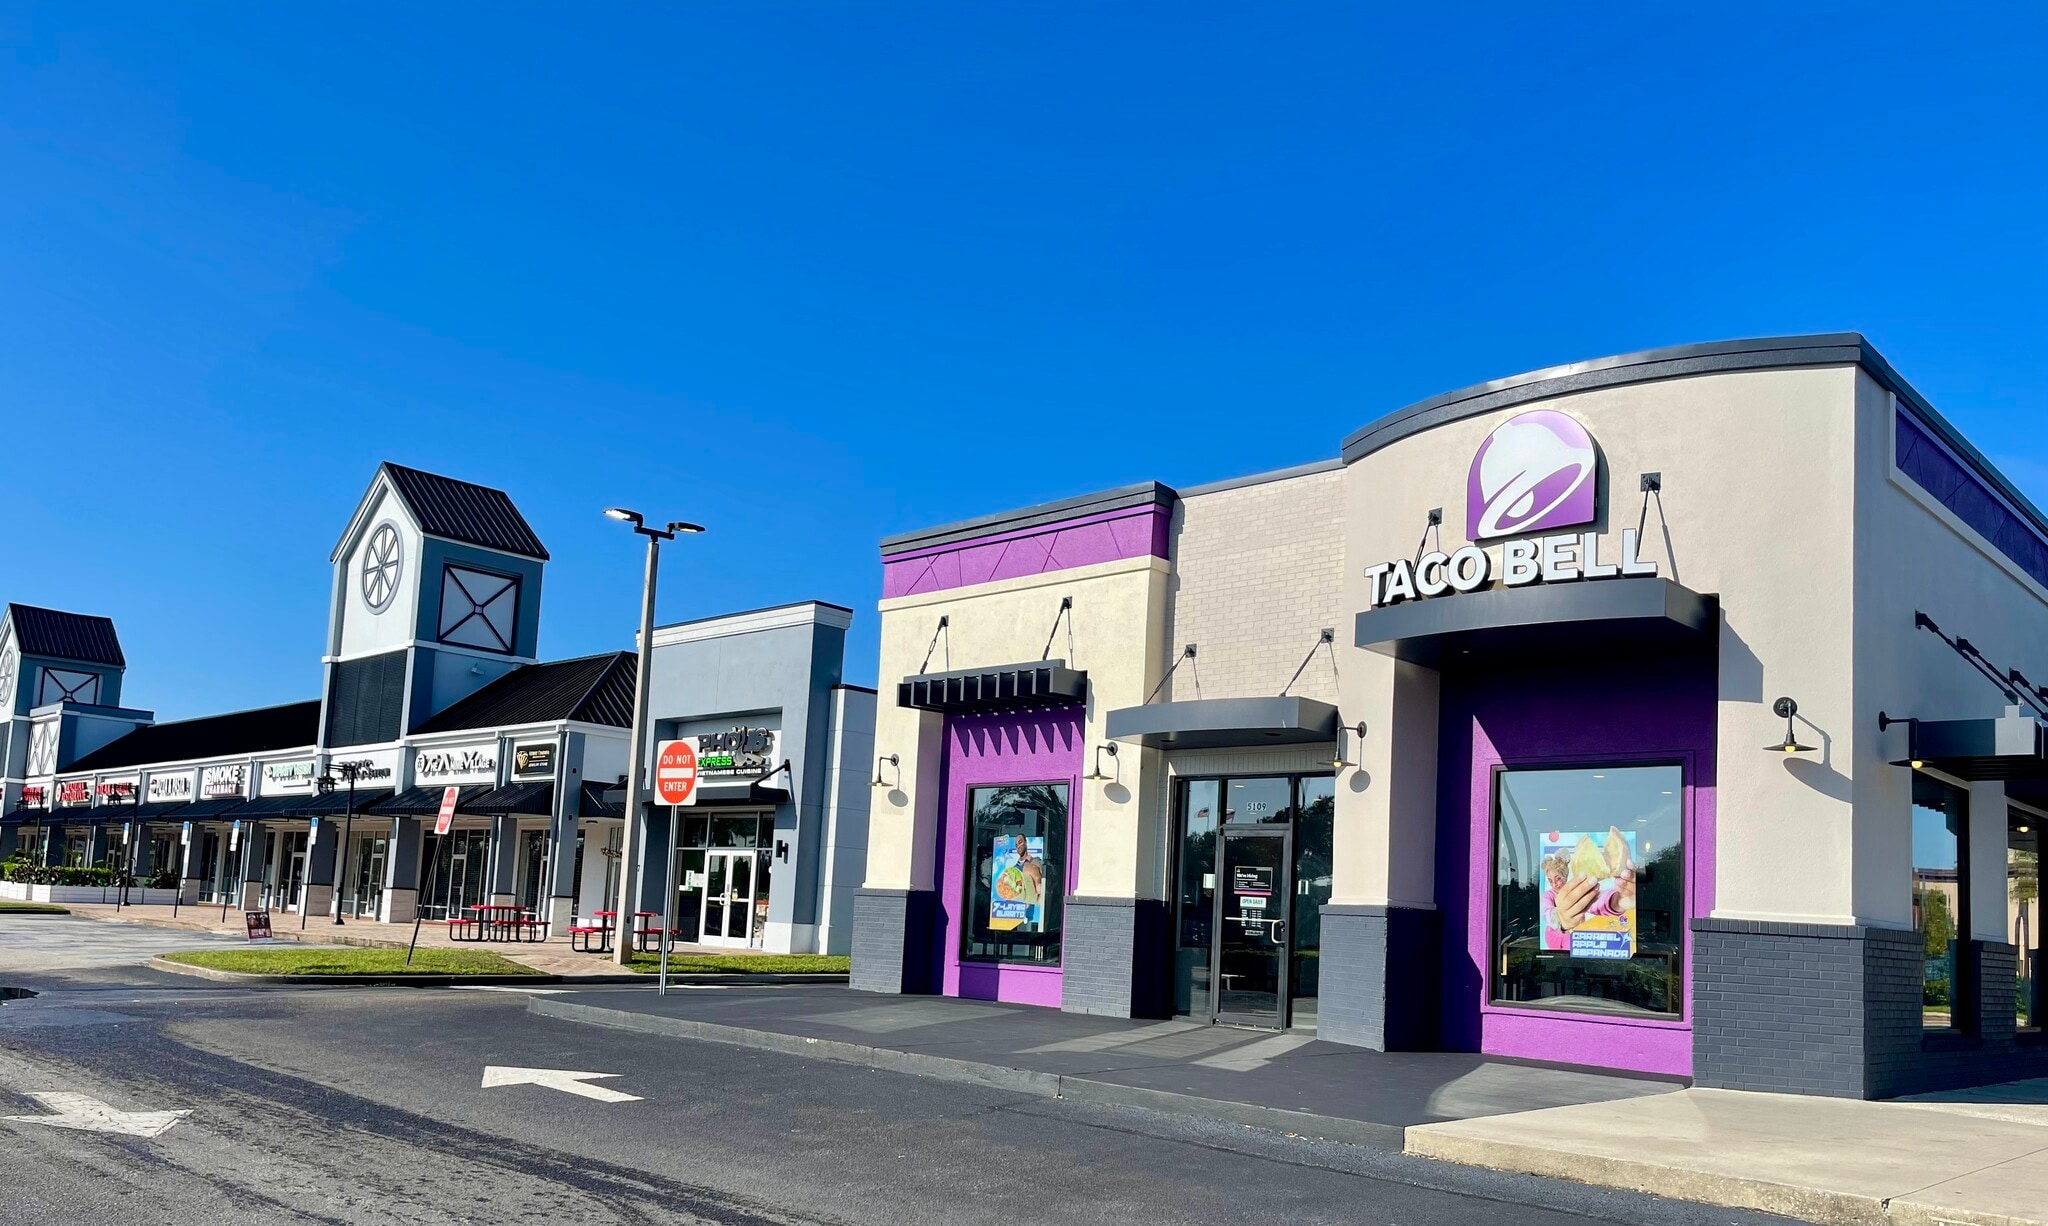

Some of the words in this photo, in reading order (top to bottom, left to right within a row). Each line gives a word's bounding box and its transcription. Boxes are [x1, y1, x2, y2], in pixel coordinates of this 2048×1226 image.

[1364, 545, 1489, 607] TACO
[1503, 528, 1658, 588] BELL
[663, 755, 675, 765] DO
[676, 754, 691, 764] NOT
[698, 756, 733, 767] EXPRESS
[206, 765, 240, 783] SMOKE
[697, 769, 735, 777] VIETNAMESE
[736, 767, 762, 775] CUISINE
[205, 784, 237, 795] PHARMACY
[664, 781, 688, 792] ENTER
[1247, 802, 1267, 811] 5109
[1572, 932, 1621, 941] CARAMEL
[1572, 940, 1608, 949] APPLE
